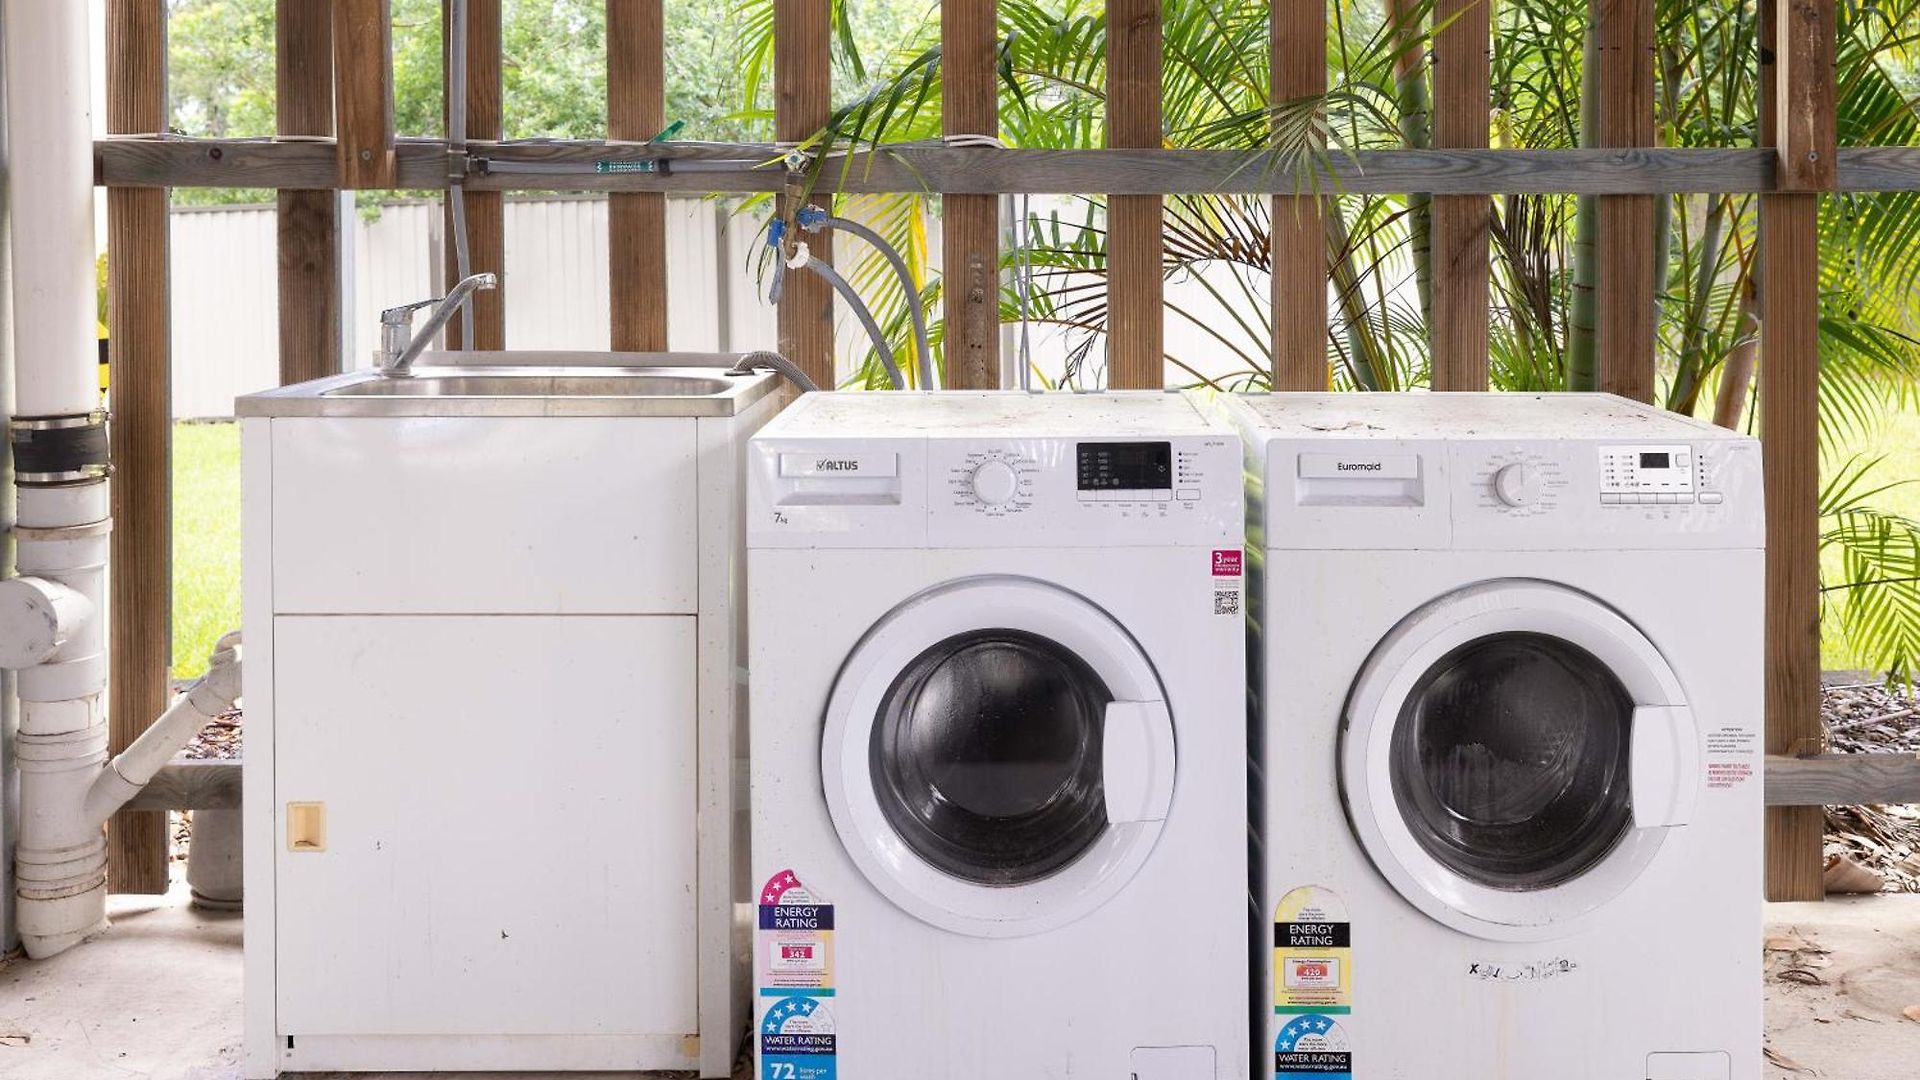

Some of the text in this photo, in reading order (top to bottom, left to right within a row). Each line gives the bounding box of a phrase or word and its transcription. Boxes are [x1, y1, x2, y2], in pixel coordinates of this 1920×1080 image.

[826, 460, 858, 470] ALTUS
[1337, 462, 1382, 472] Euromaid
[1215, 552, 1222, 564] 3
[774, 906, 819, 917] ENERGY
[775, 918, 818, 928] RATING
[1289, 924, 1335, 935] ENERGY
[1290, 936, 1333, 946] RATING
[765, 1036, 832, 1045] WATER RATING
[1279, 1054, 1346, 1062] WATER RATING
[770, 1062, 796, 1079] 72
